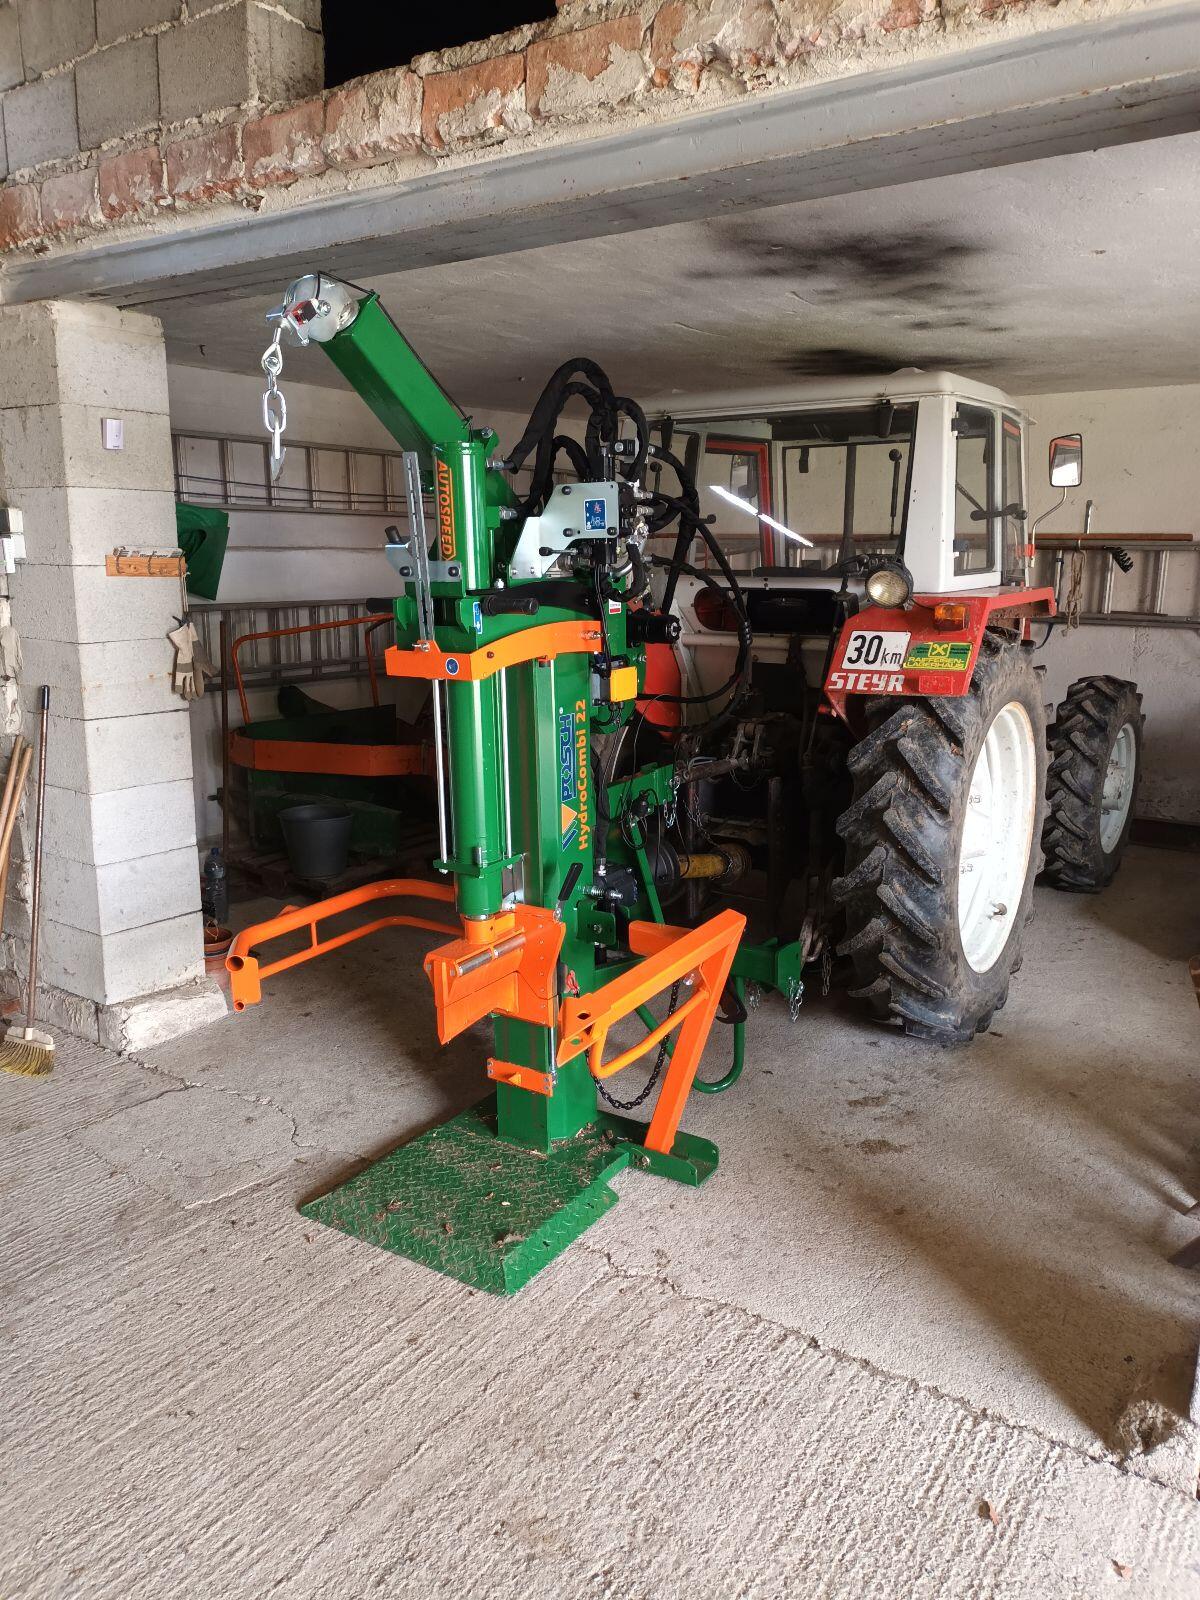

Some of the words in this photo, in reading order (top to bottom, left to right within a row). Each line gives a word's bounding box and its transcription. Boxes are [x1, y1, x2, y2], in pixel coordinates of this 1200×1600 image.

[437, 460, 453, 555] AUTOSPEED
[847, 634, 884, 665] 30
[880, 648, 902, 666] km
[576, 699, 586, 722] 22
[828, 672, 905, 692] STEYR
[559, 713, 575, 802] POSCH
[576, 730, 590, 850] HydroCombi
